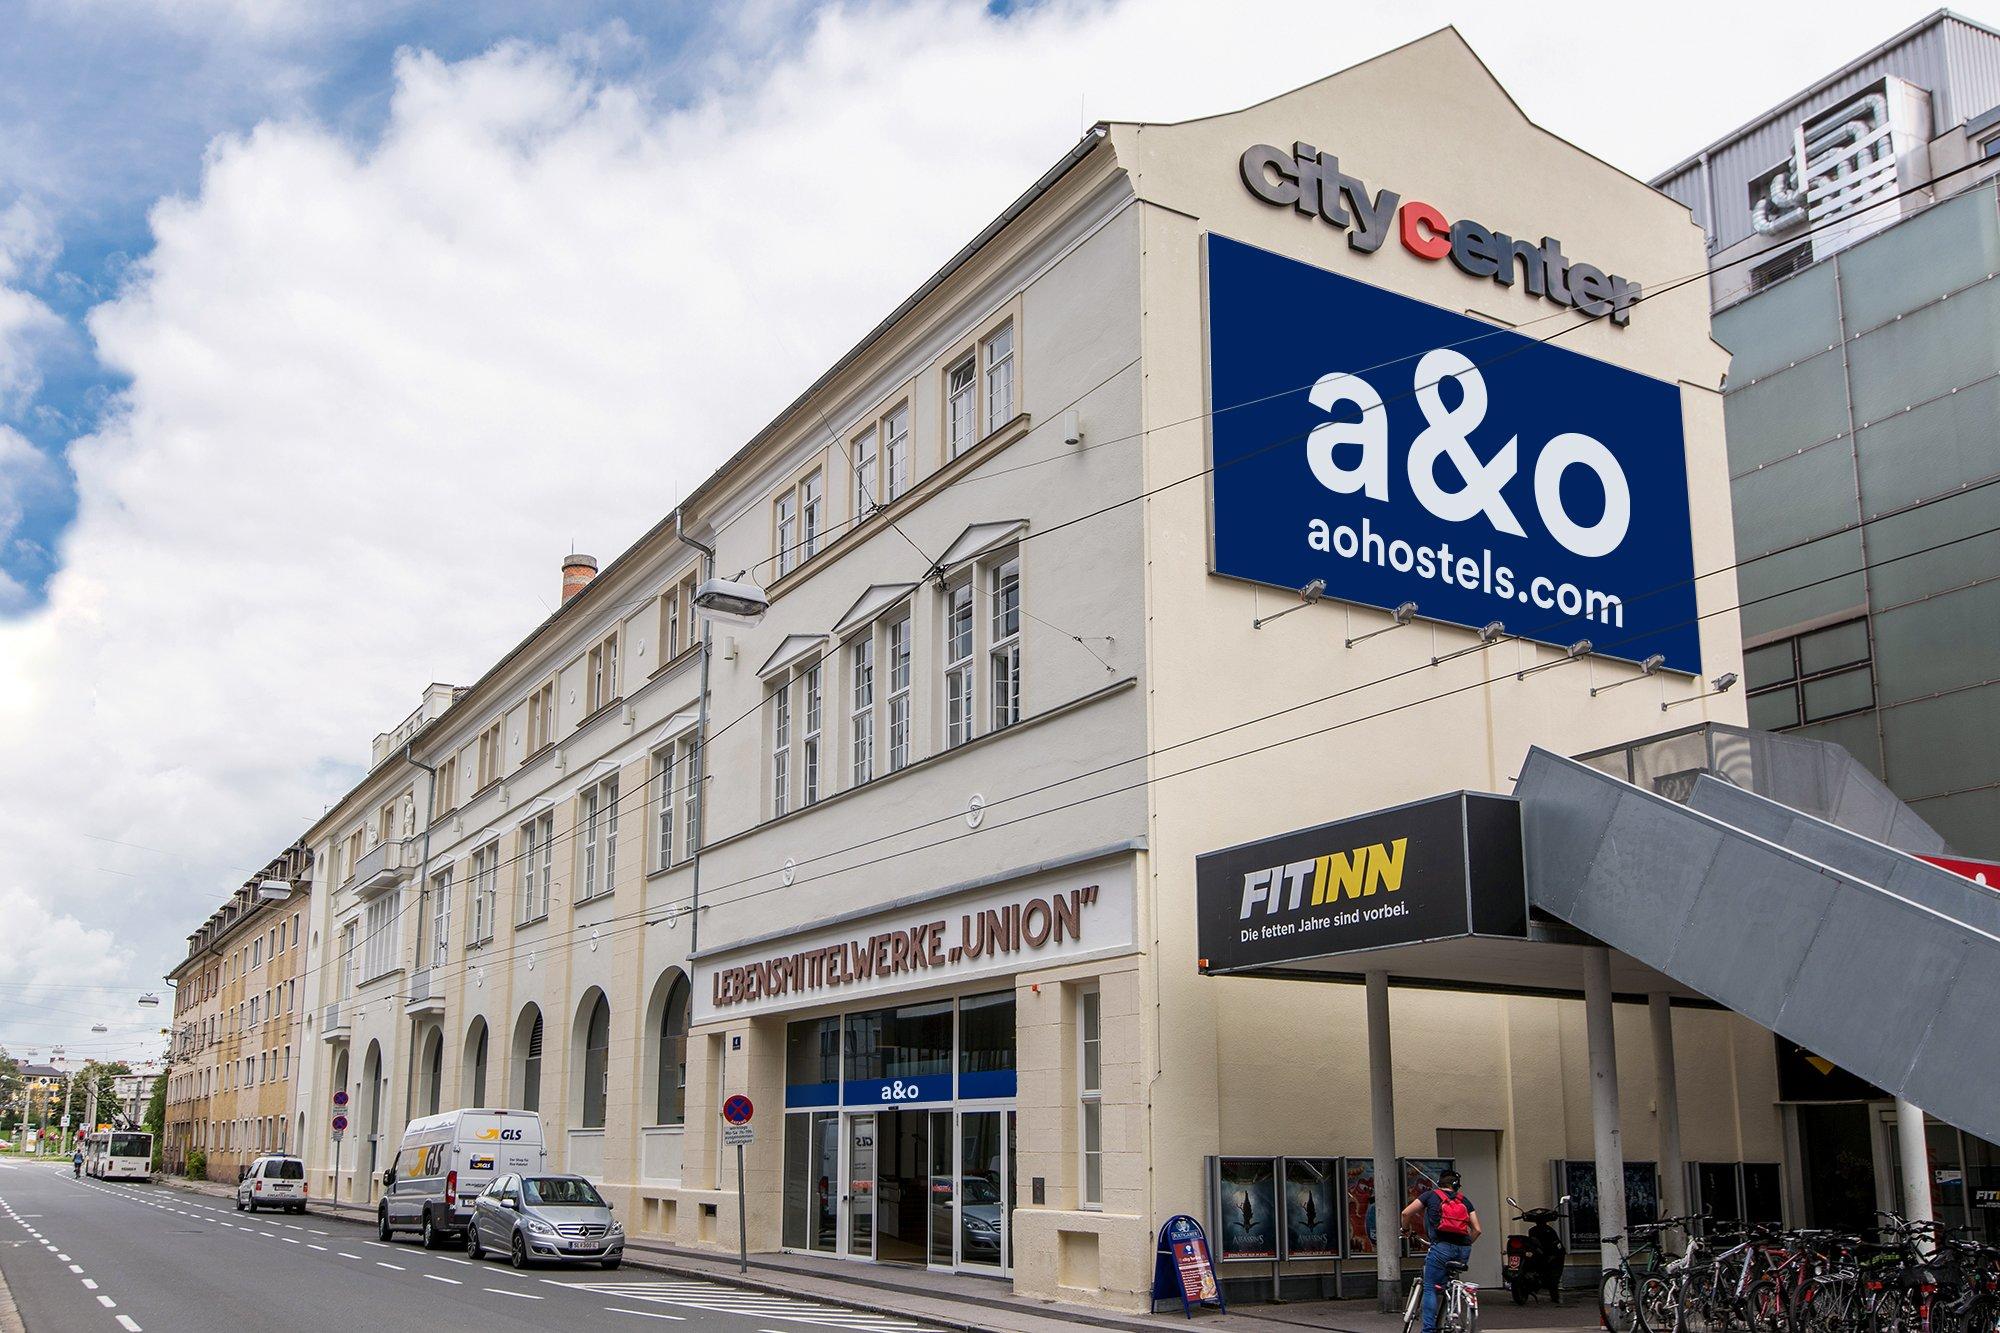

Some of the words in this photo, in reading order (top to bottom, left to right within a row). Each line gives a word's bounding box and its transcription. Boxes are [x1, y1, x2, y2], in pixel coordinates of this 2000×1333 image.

[1306, 348, 1630, 557] a&o
[1307, 517, 1623, 627] aohostels.com
[1239, 837, 1408, 920] FITINN
[1241, 929, 1259, 942] Die
[1261, 922, 1295, 939] fetten
[1298, 915, 1331, 933] Jahre
[1333, 910, 1360, 927] sind
[1362, 900, 1409, 921] vorbei.
[712, 920, 946, 1007] LEBENSMITTELWERKE
[881, 1080, 919, 1100] a&o
[425, 1144, 445, 1176] GLS
[501, 1129, 522, 1141] GLS
